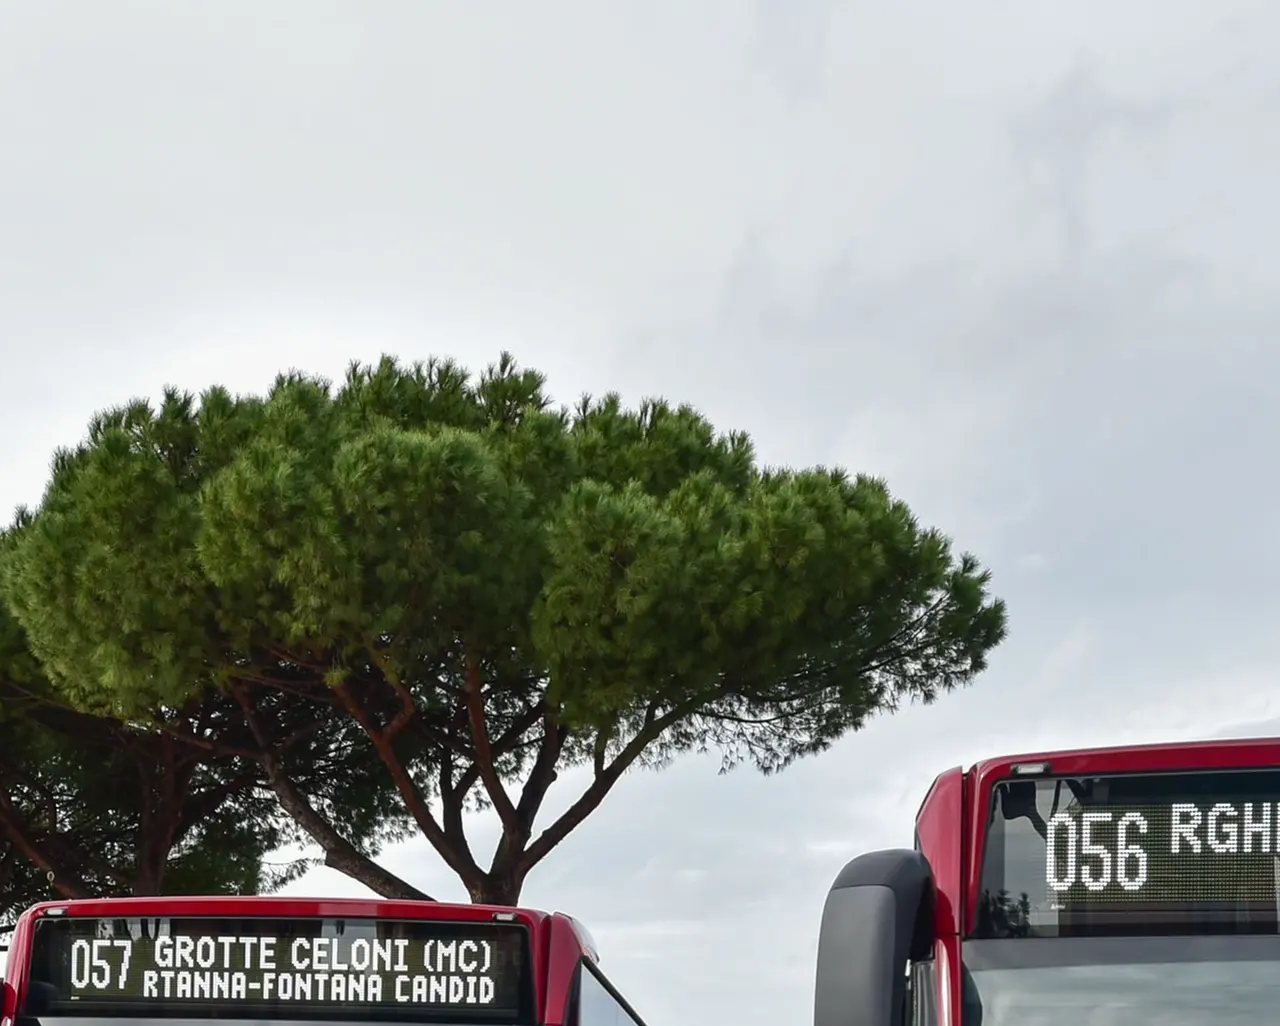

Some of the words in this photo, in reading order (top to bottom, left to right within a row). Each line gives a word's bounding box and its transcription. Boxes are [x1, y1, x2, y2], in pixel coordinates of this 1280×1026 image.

[1046, 810, 1148, 892] 056
[71, 939, 132, 989] 057
[155, 935, 277, 969] GROTTE
[291, 938, 409, 972] CELONI
[423, 940, 491, 973] (MC)
[143, 970, 382, 1002] RTANNA-FONTANA
[395, 975, 495, 1004] CANDID
